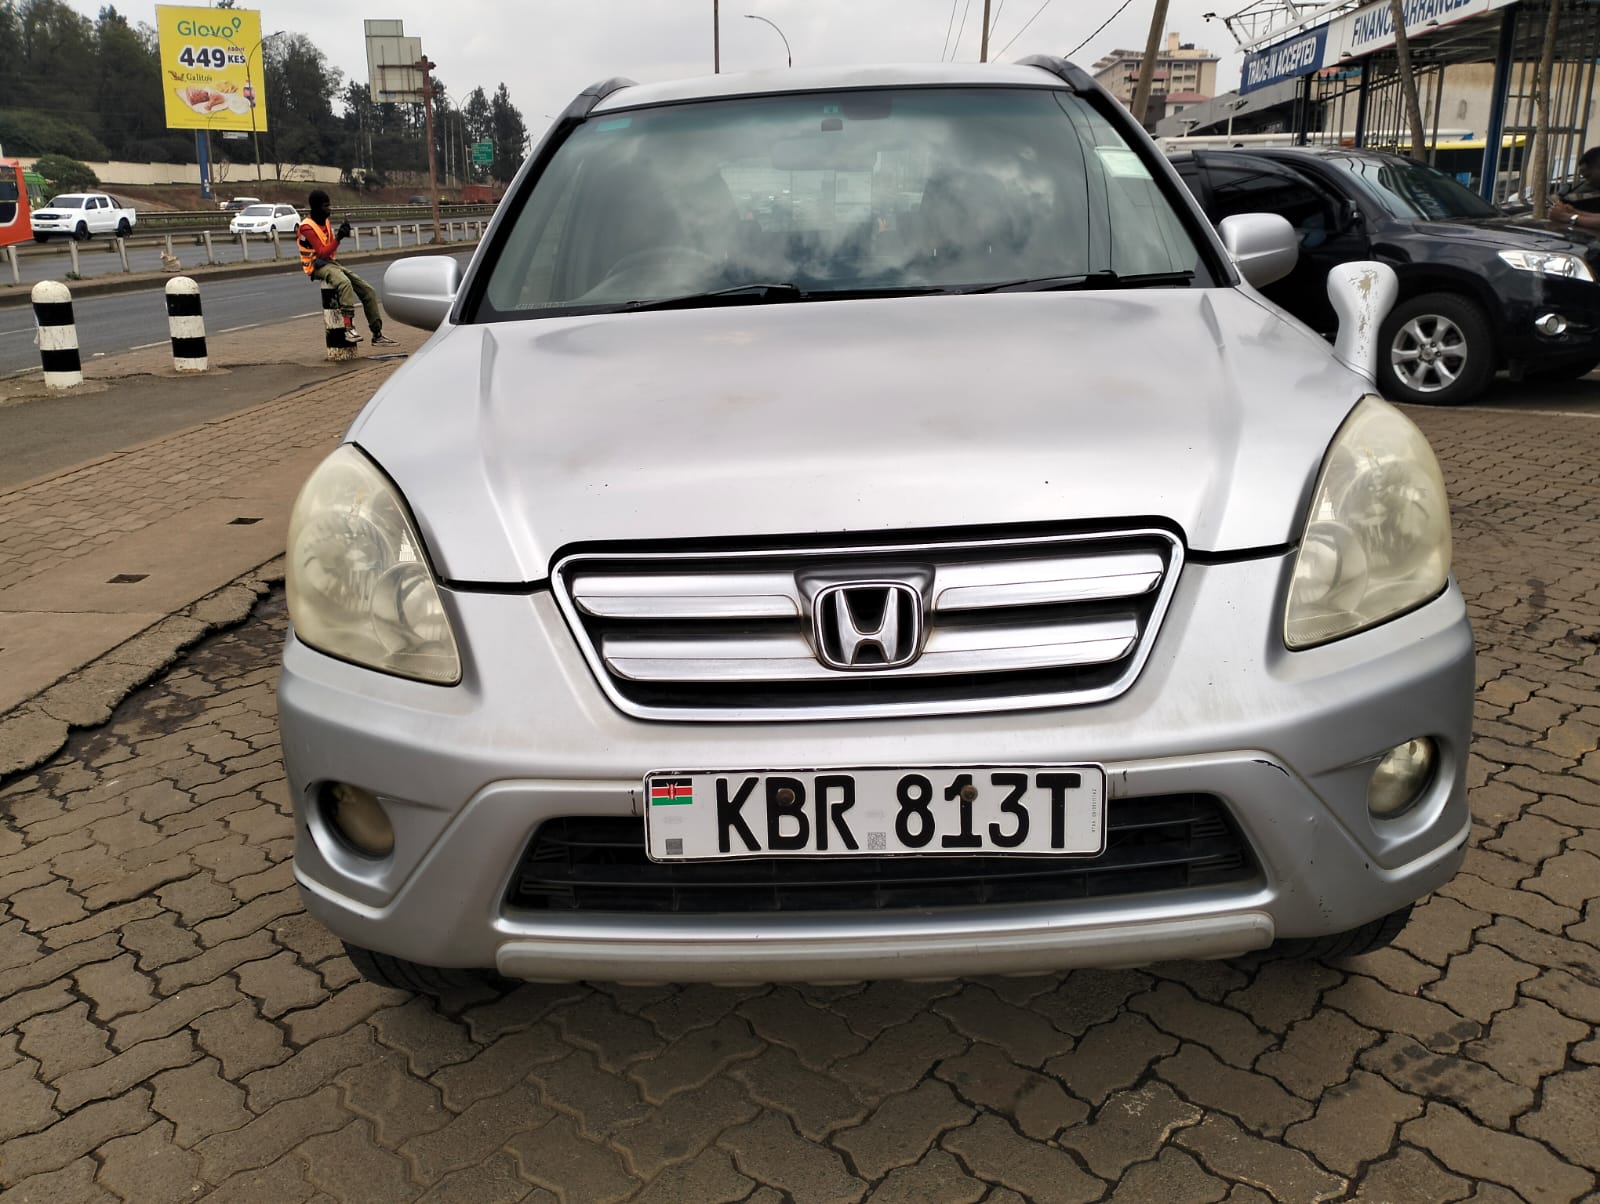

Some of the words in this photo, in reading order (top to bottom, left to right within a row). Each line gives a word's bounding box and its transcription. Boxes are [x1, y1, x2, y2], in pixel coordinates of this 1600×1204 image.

[177, 20, 234, 38] Glovo
[179, 47, 226, 68] 449
[227, 54, 246, 64] KES
[1247, 52, 1278, 86] TRADE-IN
[1277, 37, 1317, 75] ACCEPTED
[715, 774, 860, 853] KBR
[895, 772, 1082, 849] 813T
